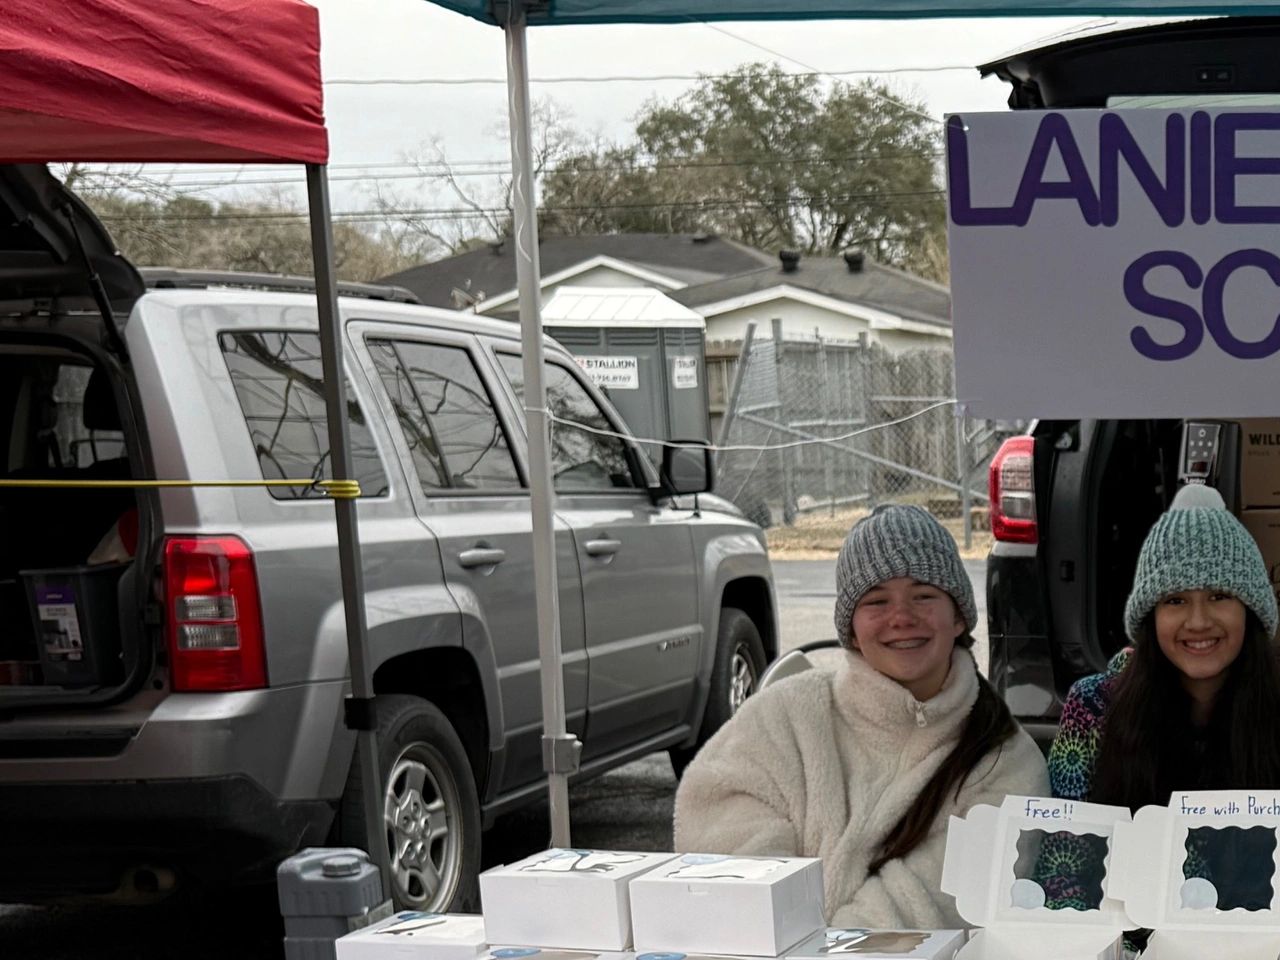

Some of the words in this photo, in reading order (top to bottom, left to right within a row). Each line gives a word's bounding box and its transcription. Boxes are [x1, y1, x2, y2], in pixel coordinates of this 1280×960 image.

[586, 359, 636, 369] STALLION
[1024, 799, 1073, 820] Free!!
[1181, 796, 1207, 815] Free
[1213, 800, 1240, 815] with
